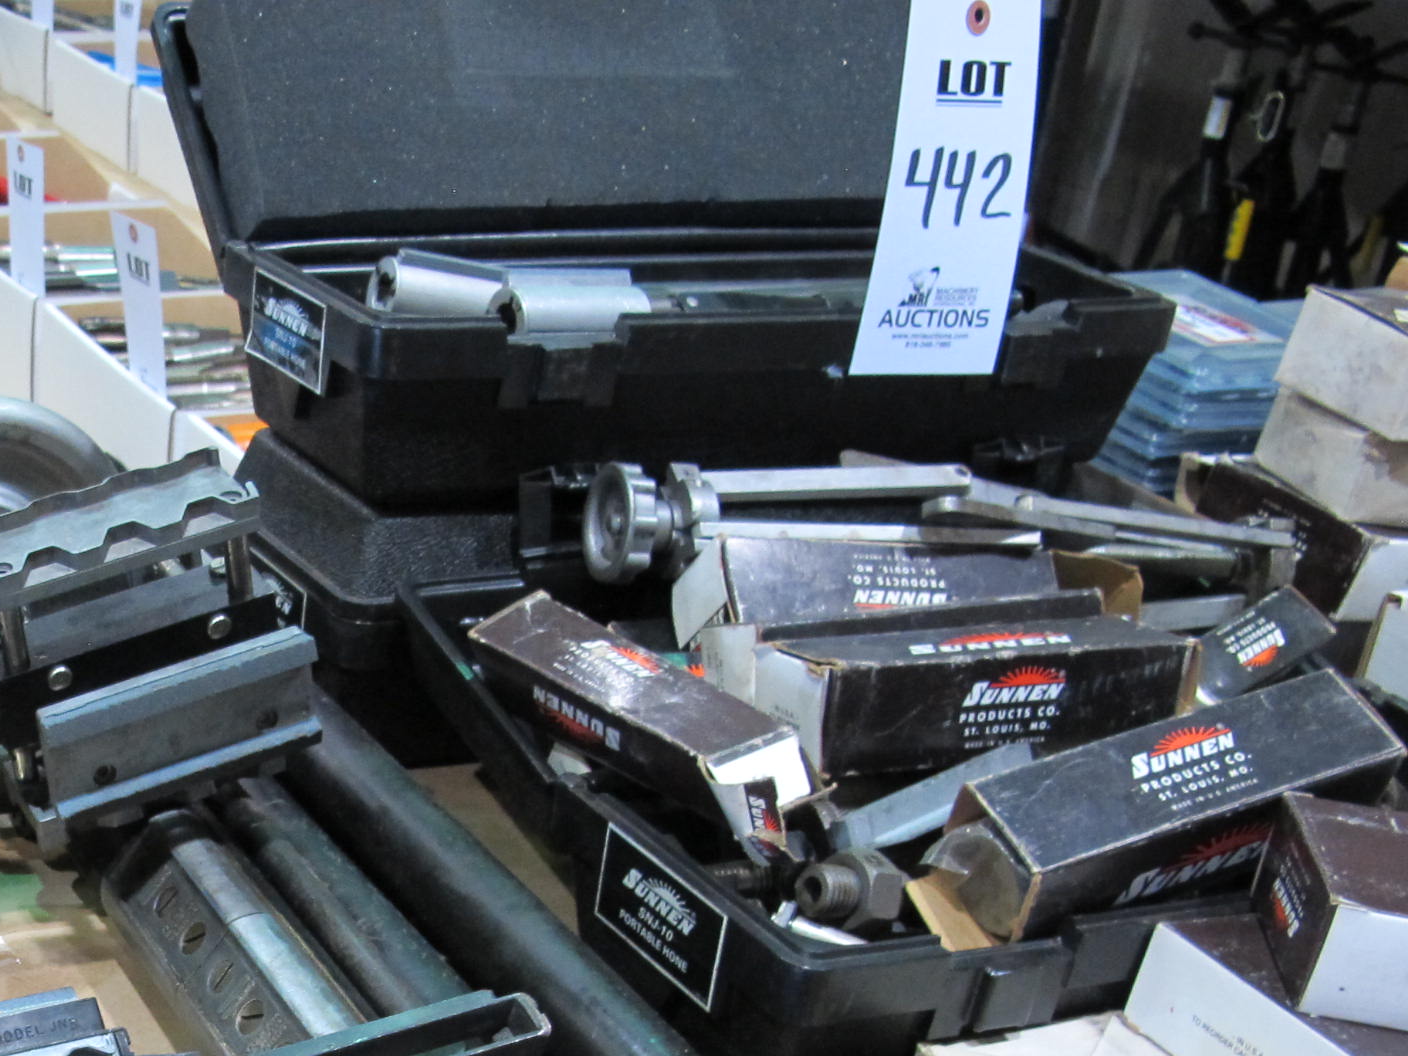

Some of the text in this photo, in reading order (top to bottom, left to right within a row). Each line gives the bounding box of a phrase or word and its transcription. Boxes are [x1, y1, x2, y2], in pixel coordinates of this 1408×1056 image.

[937, 59, 1012, 97] LOT
[14, 170, 33, 196] LOT
[904, 146, 1013, 229] 442
[126, 252, 150, 283] LOT
[877, 308, 991, 328] AUCTIONS
[908, 634, 1072, 656] SUNNEN
[1237, 628, 1286, 665] SUNNEN
[961, 680, 1066, 708] SUNNEN
[532, 684, 621, 751] SUNNEN
[958, 705, 1061, 725] PRODUCTS CO.
[963, 726, 980, 737] ST.
[1029, 722, 1052, 731] MO.
[1131, 731, 1235, 780] SUNNEN
[1140, 752, 1253, 793] PRODUCTS CO.
[1158, 790, 1178, 801] ST.
[1228, 766, 1253, 778] MO.
[622, 868, 697, 937] SUNNEN
[619, 908, 689, 974] PORTABLE HONE
[637, 906, 674, 943] SNJ-10
